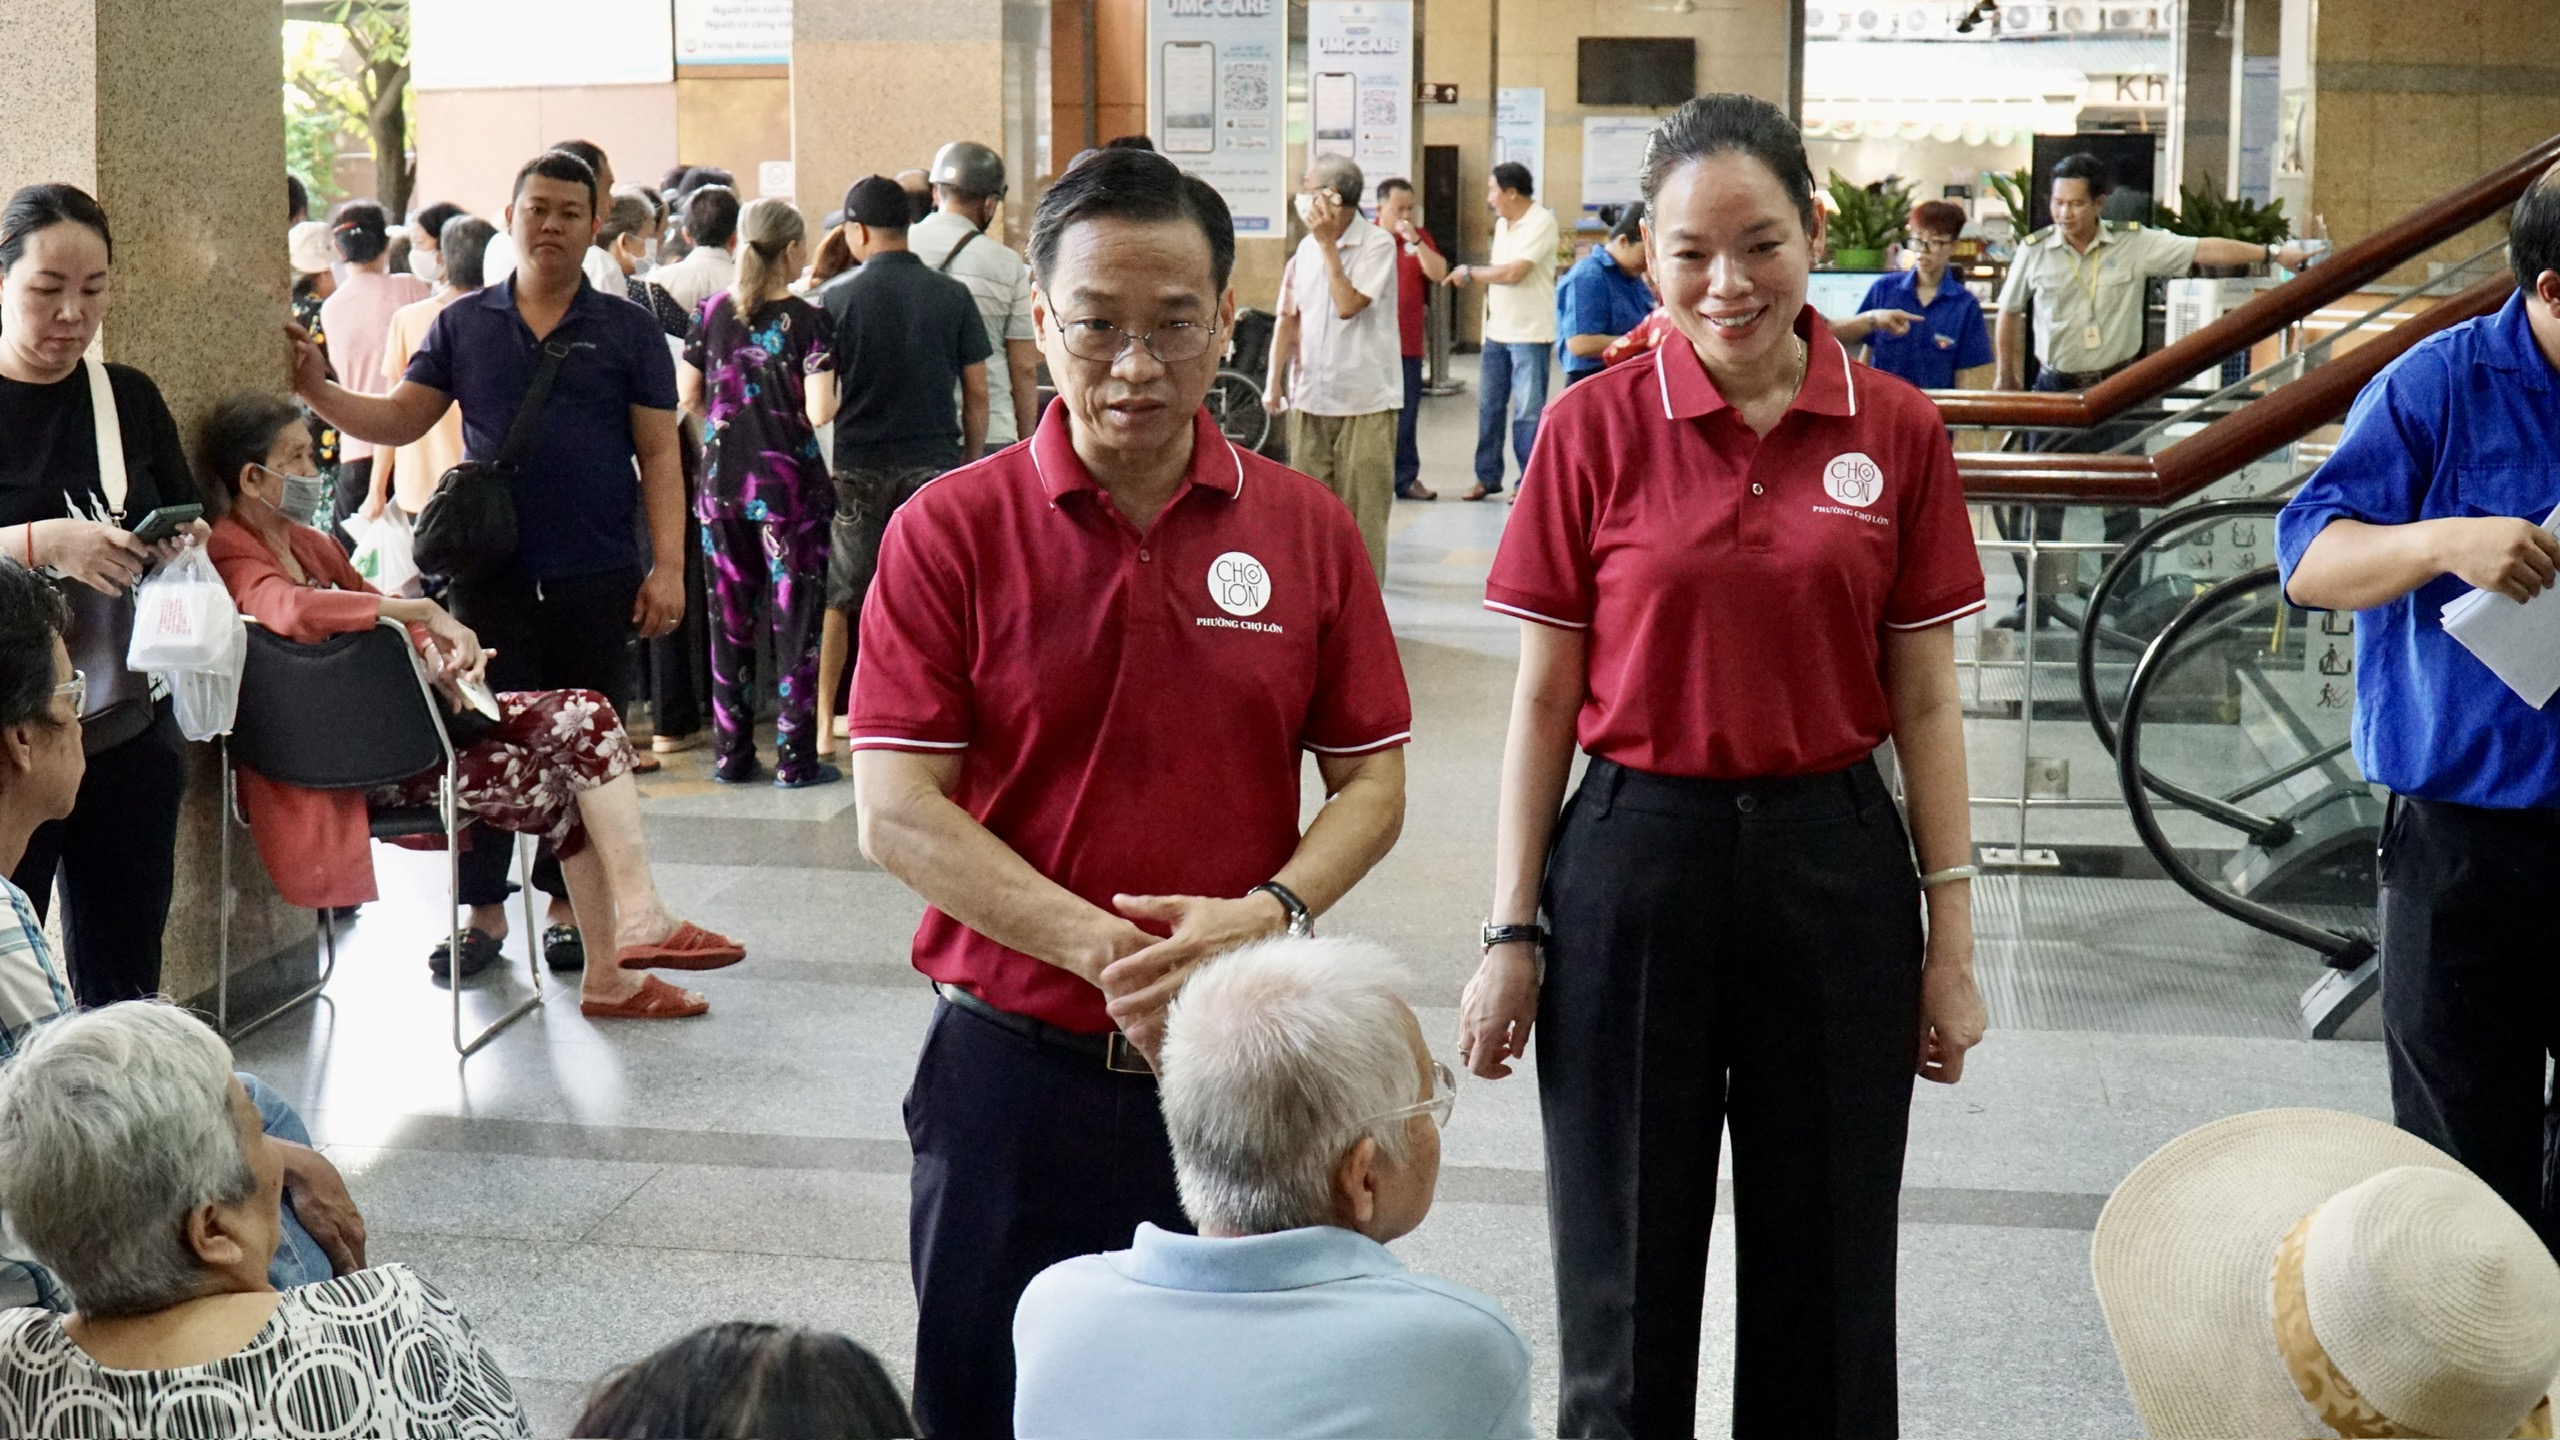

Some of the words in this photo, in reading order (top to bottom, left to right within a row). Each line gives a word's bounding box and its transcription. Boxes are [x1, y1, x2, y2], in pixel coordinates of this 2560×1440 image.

[1812, 505, 1853, 516] PHƯỜNG
[1854, 510, 1872, 522] CHỢ
[1872, 514, 1889, 526] LỚN
[1196, 617, 1239, 628] PHƯỜNG
[1240, 621, 1262, 632] CHỢ
[1263, 622, 1283, 634] LỚN
